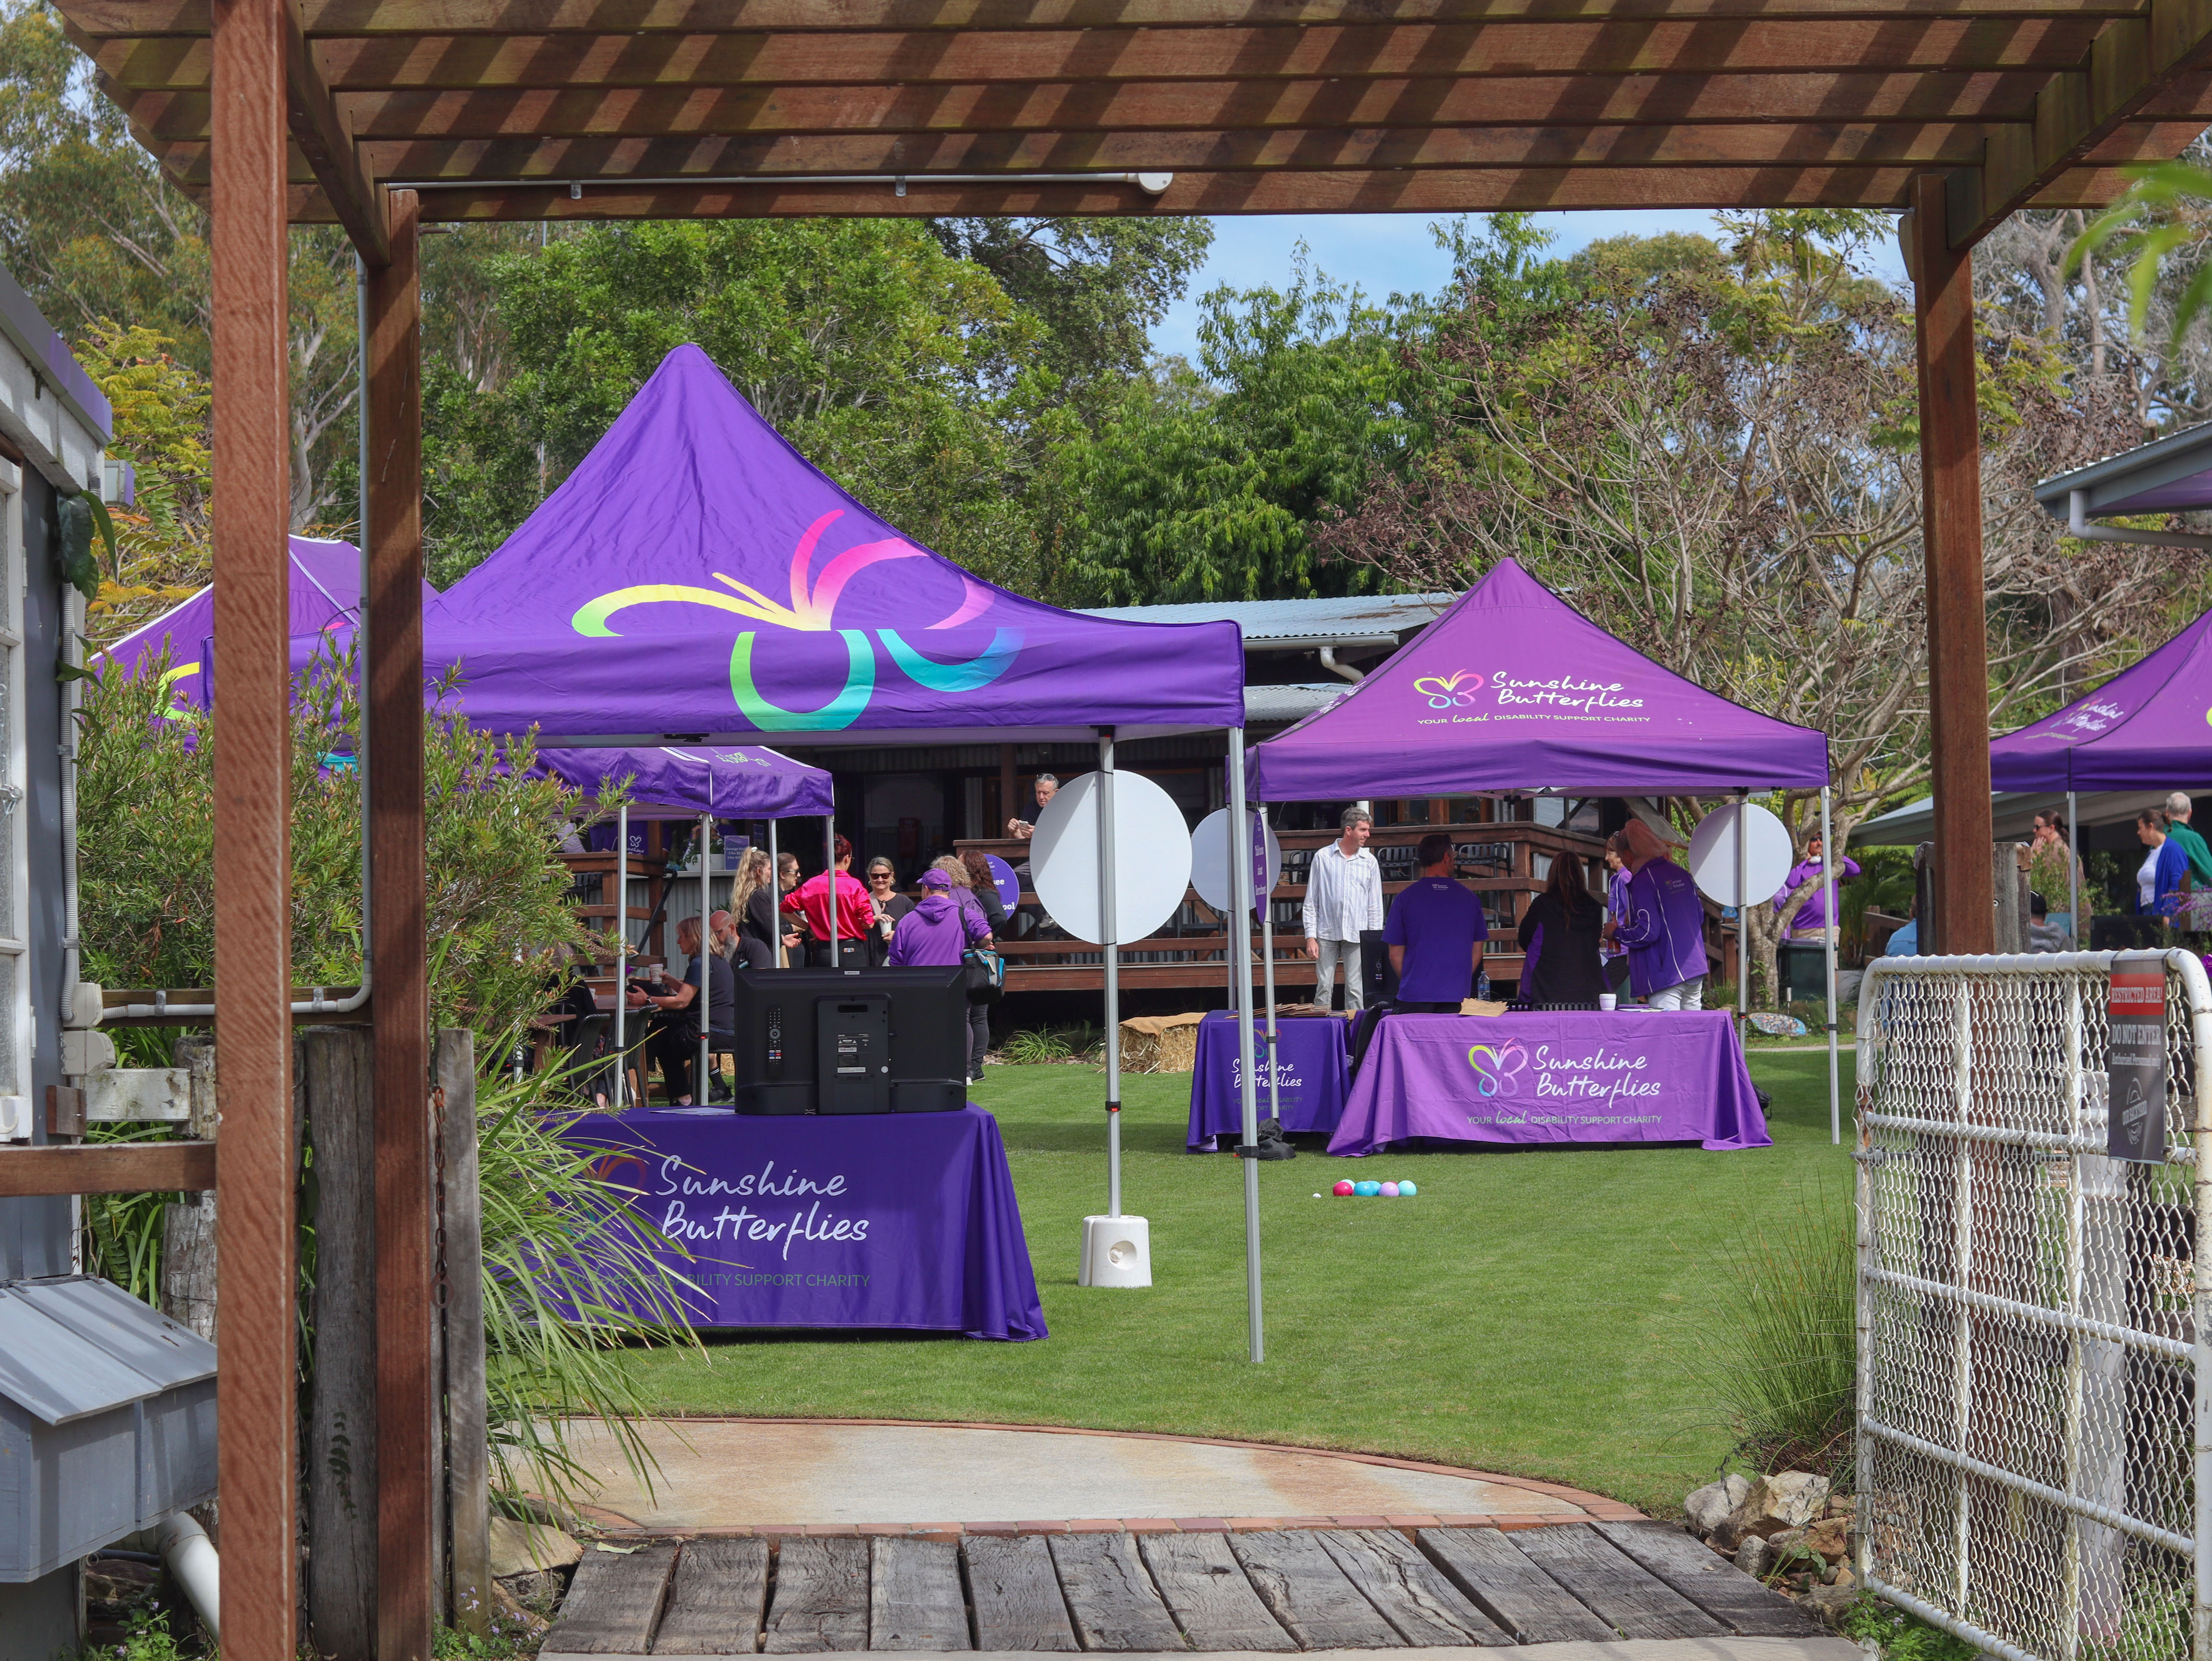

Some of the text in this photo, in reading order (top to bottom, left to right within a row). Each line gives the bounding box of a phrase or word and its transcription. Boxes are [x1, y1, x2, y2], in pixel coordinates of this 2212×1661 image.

[1490, 671, 1624, 691] Sunshine
[1498, 688, 1644, 713] Butterflies
[1453, 713, 1490, 723] local
[2111, 986, 2163, 1003] RESTRICTED AREA!
[2112, 1024, 2161, 1045] DO NOT ENTER
[1533, 1045, 1648, 1071] Sunshine
[1537, 1072, 1661, 1109] Butterflies
[1495, 1110, 1527, 1124] local
[1531, 1116, 1578, 1124] DISABILITY
[1580, 1116, 1621, 1124] SUPPORT
[1623, 1115, 1662, 1124] CHARITY
[655, 1154, 848, 1196] Sunshine
[661, 1200, 870, 1262] Butterflies
[653, 1274, 732, 1286] DSABILITY
[734, 1274, 803, 1286] SUPPORT
[805, 1274, 871, 1287] CHARITY
